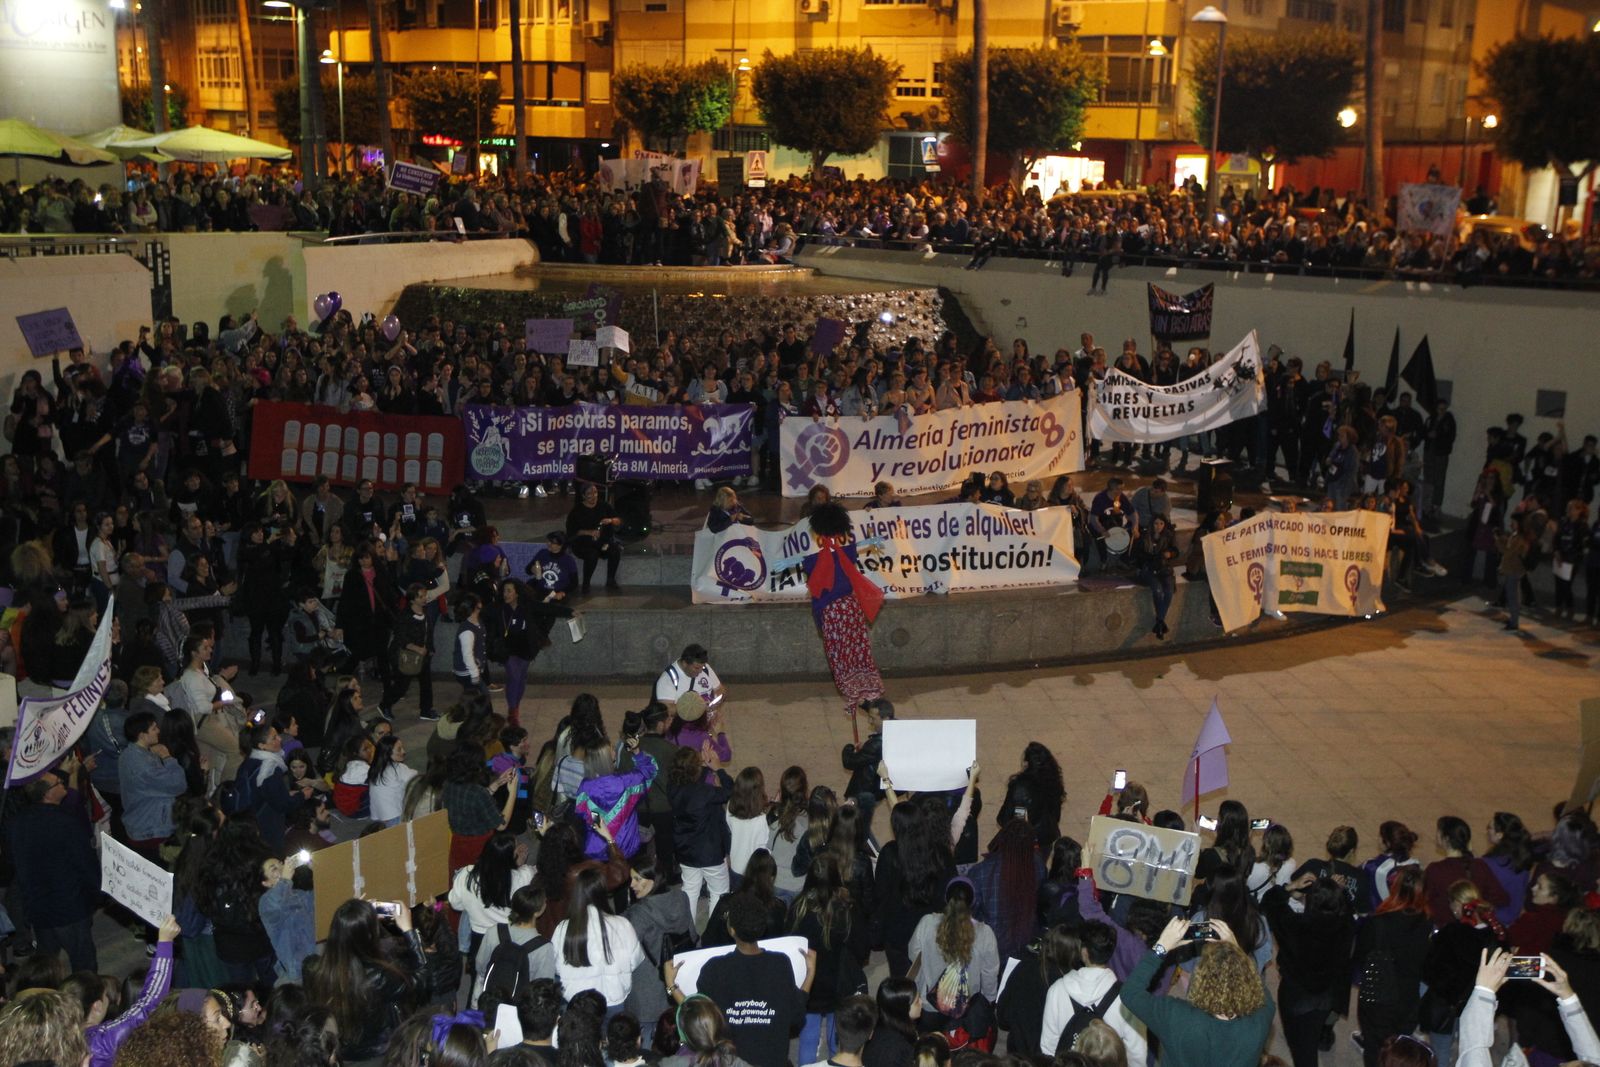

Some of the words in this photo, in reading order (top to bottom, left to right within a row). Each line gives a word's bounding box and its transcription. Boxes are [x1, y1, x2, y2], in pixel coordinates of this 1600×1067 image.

[1164, 373, 1212, 394] PASIVAS
[1146, 392, 1154, 403] Y
[1112, 400, 1195, 419] REVUELTAS
[521, 412, 542, 436] ¡Si
[548, 411, 616, 430] nosotras
[621, 413, 692, 433] paramos,
[853, 422, 943, 450] Almería
[948, 412, 1040, 447] feminista
[1040, 412, 1064, 448] 8
[537, 439, 555, 455] se
[559, 438, 595, 457] para
[599, 435, 614, 452] el
[619, 436, 677, 454] mundo!
[523, 461, 575, 475] Asamblea
[630, 461, 648, 473] 8M
[650, 459, 688, 475] Almería
[871, 462, 885, 483] y
[896, 487, 909, 495] de
[782, 530, 811, 558] ¡No
[860, 514, 932, 540] vientres
[938, 511, 960, 535] de
[965, 509, 1036, 542] alquiler!
[1308, 522, 1327, 535] NOS
[901, 545, 1053, 577] prostitución!
[1226, 555, 1238, 567] EL
[1291, 545, 1310, 557] NOS
[1314, 547, 1338, 560] HACE
[726, 1008, 740, 1016] dies
[741, 1008, 768, 1016] drowned
[735, 999, 767, 1008] everybody
[728, 1017, 743, 1025] their
[744, 1017, 771, 1025] illusions
